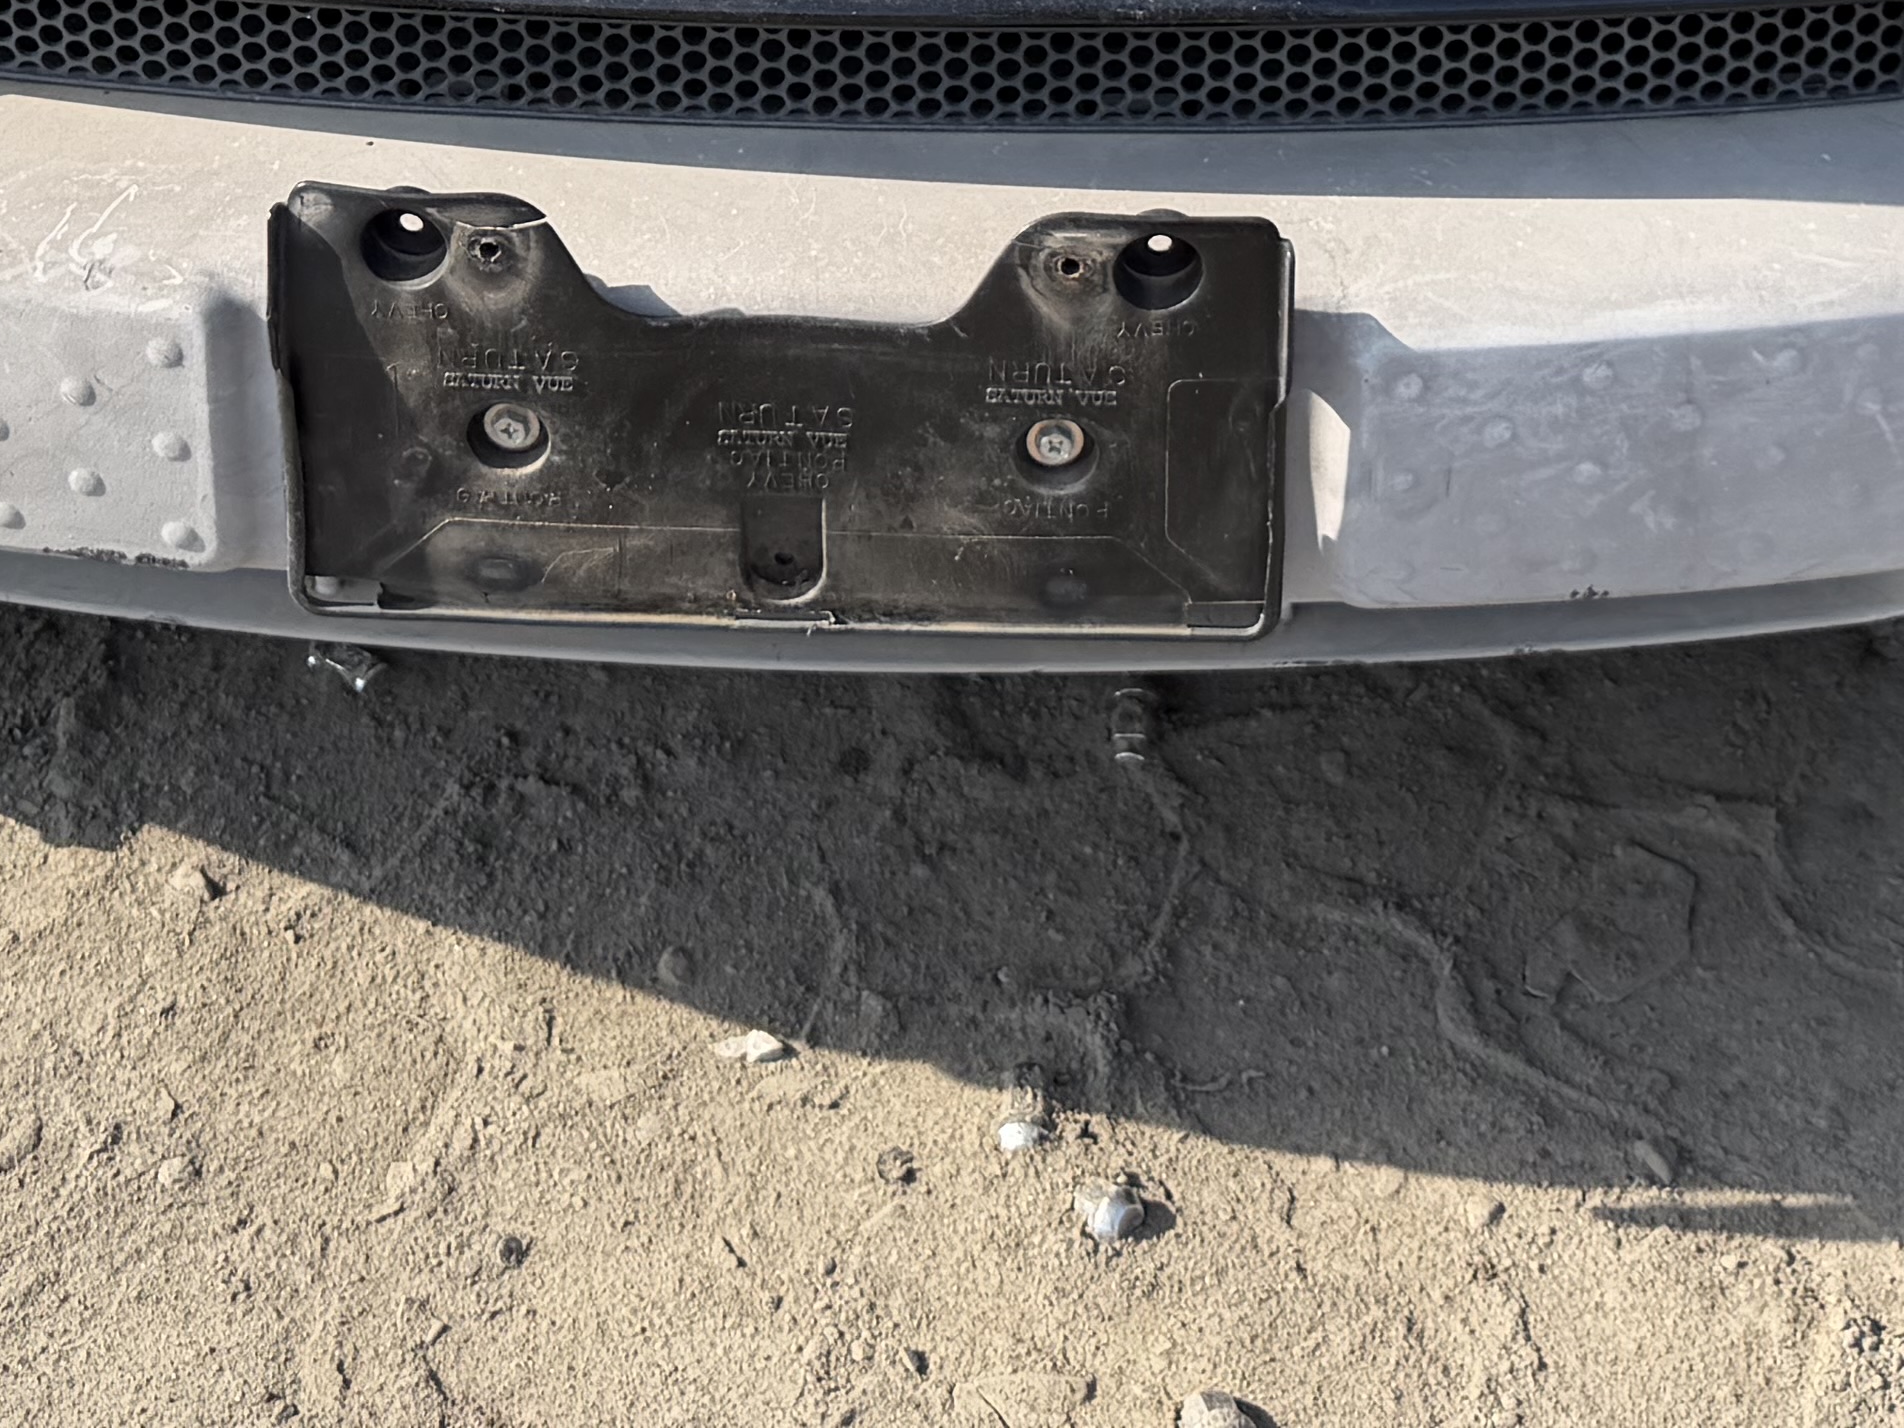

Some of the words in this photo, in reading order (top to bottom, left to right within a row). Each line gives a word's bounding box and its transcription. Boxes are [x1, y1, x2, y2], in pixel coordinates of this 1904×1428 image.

[532, 375, 574, 394] VUE
[988, 357, 1126, 386] SATURN
[718, 401, 853, 428] SATURN
